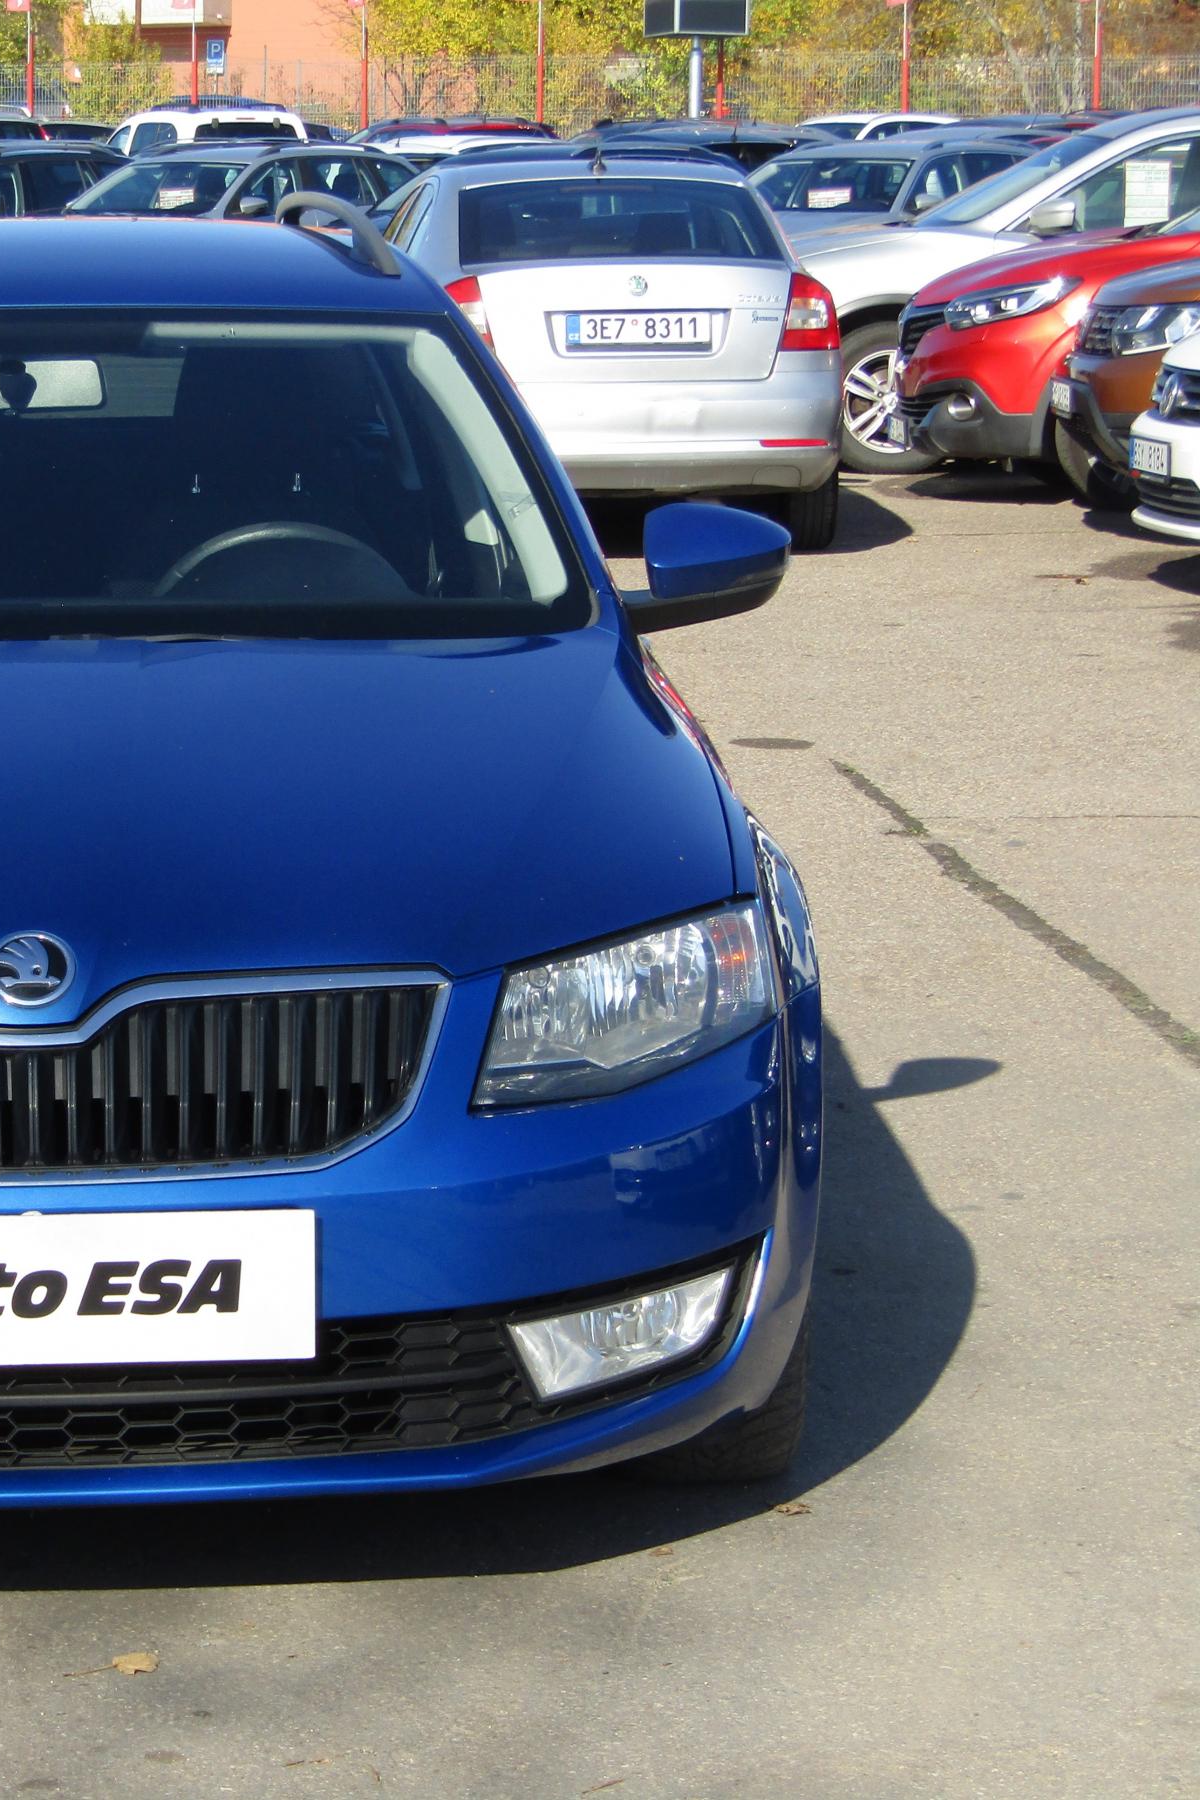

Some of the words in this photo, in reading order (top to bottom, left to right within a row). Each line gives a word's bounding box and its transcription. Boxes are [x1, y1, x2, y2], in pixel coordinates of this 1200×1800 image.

[211, 43, 221, 58] P
[586, 318, 625, 340] 3E7
[644, 317, 698, 339] 8311
[76, 1259, 242, 1317] ESA
